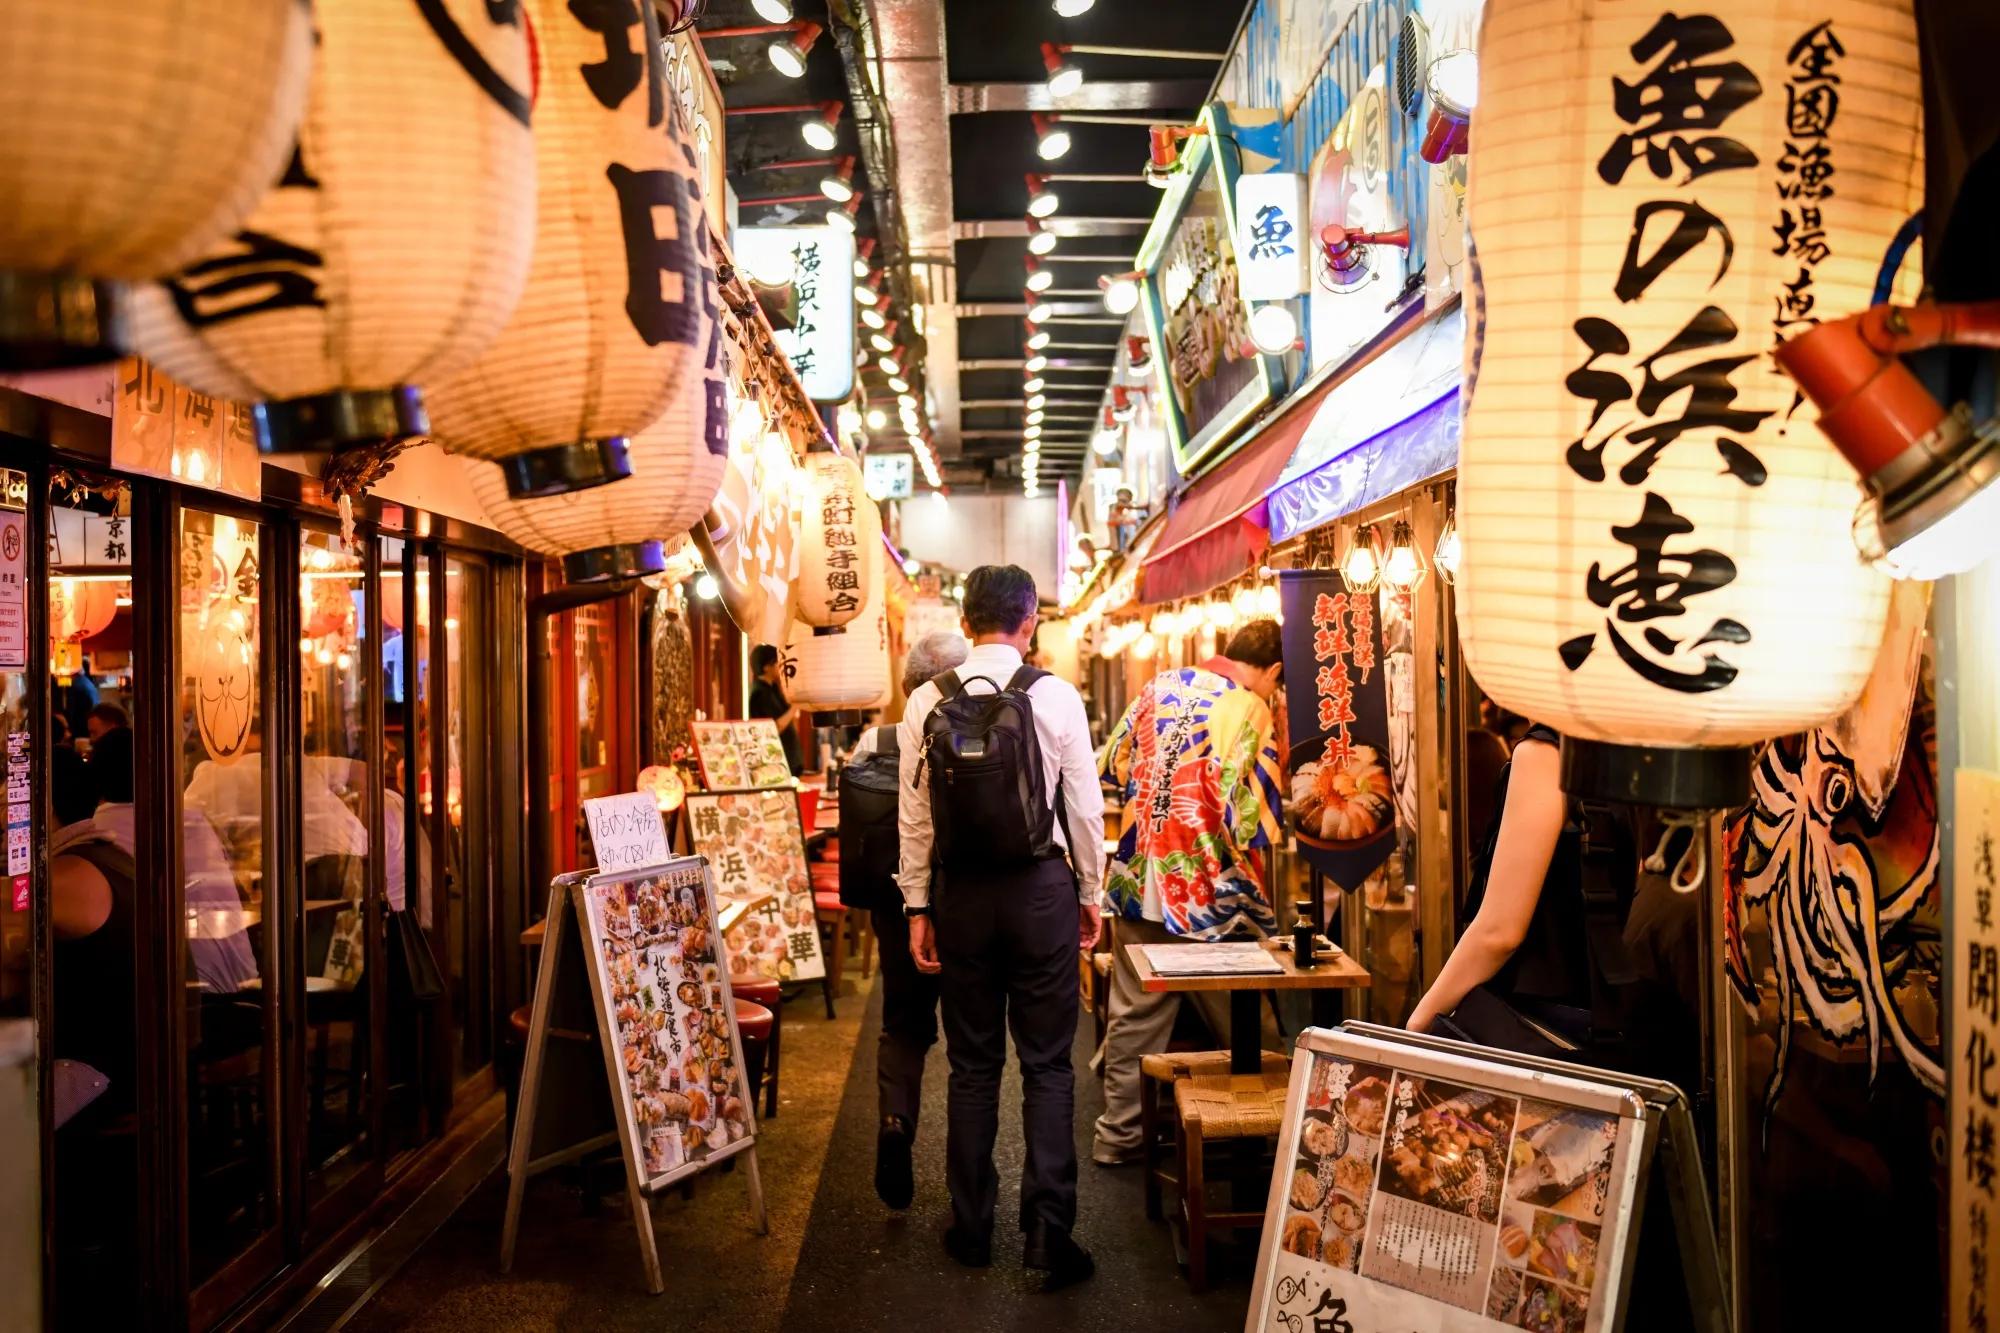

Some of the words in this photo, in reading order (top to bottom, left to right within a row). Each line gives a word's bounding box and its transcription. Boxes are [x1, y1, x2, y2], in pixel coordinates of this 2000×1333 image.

[1249, 204, 1294, 261] 魚
[1558, 11, 1778, 694] 魚の浜恵
[1312, 591, 1358, 770] 新鮮海鮮丼
